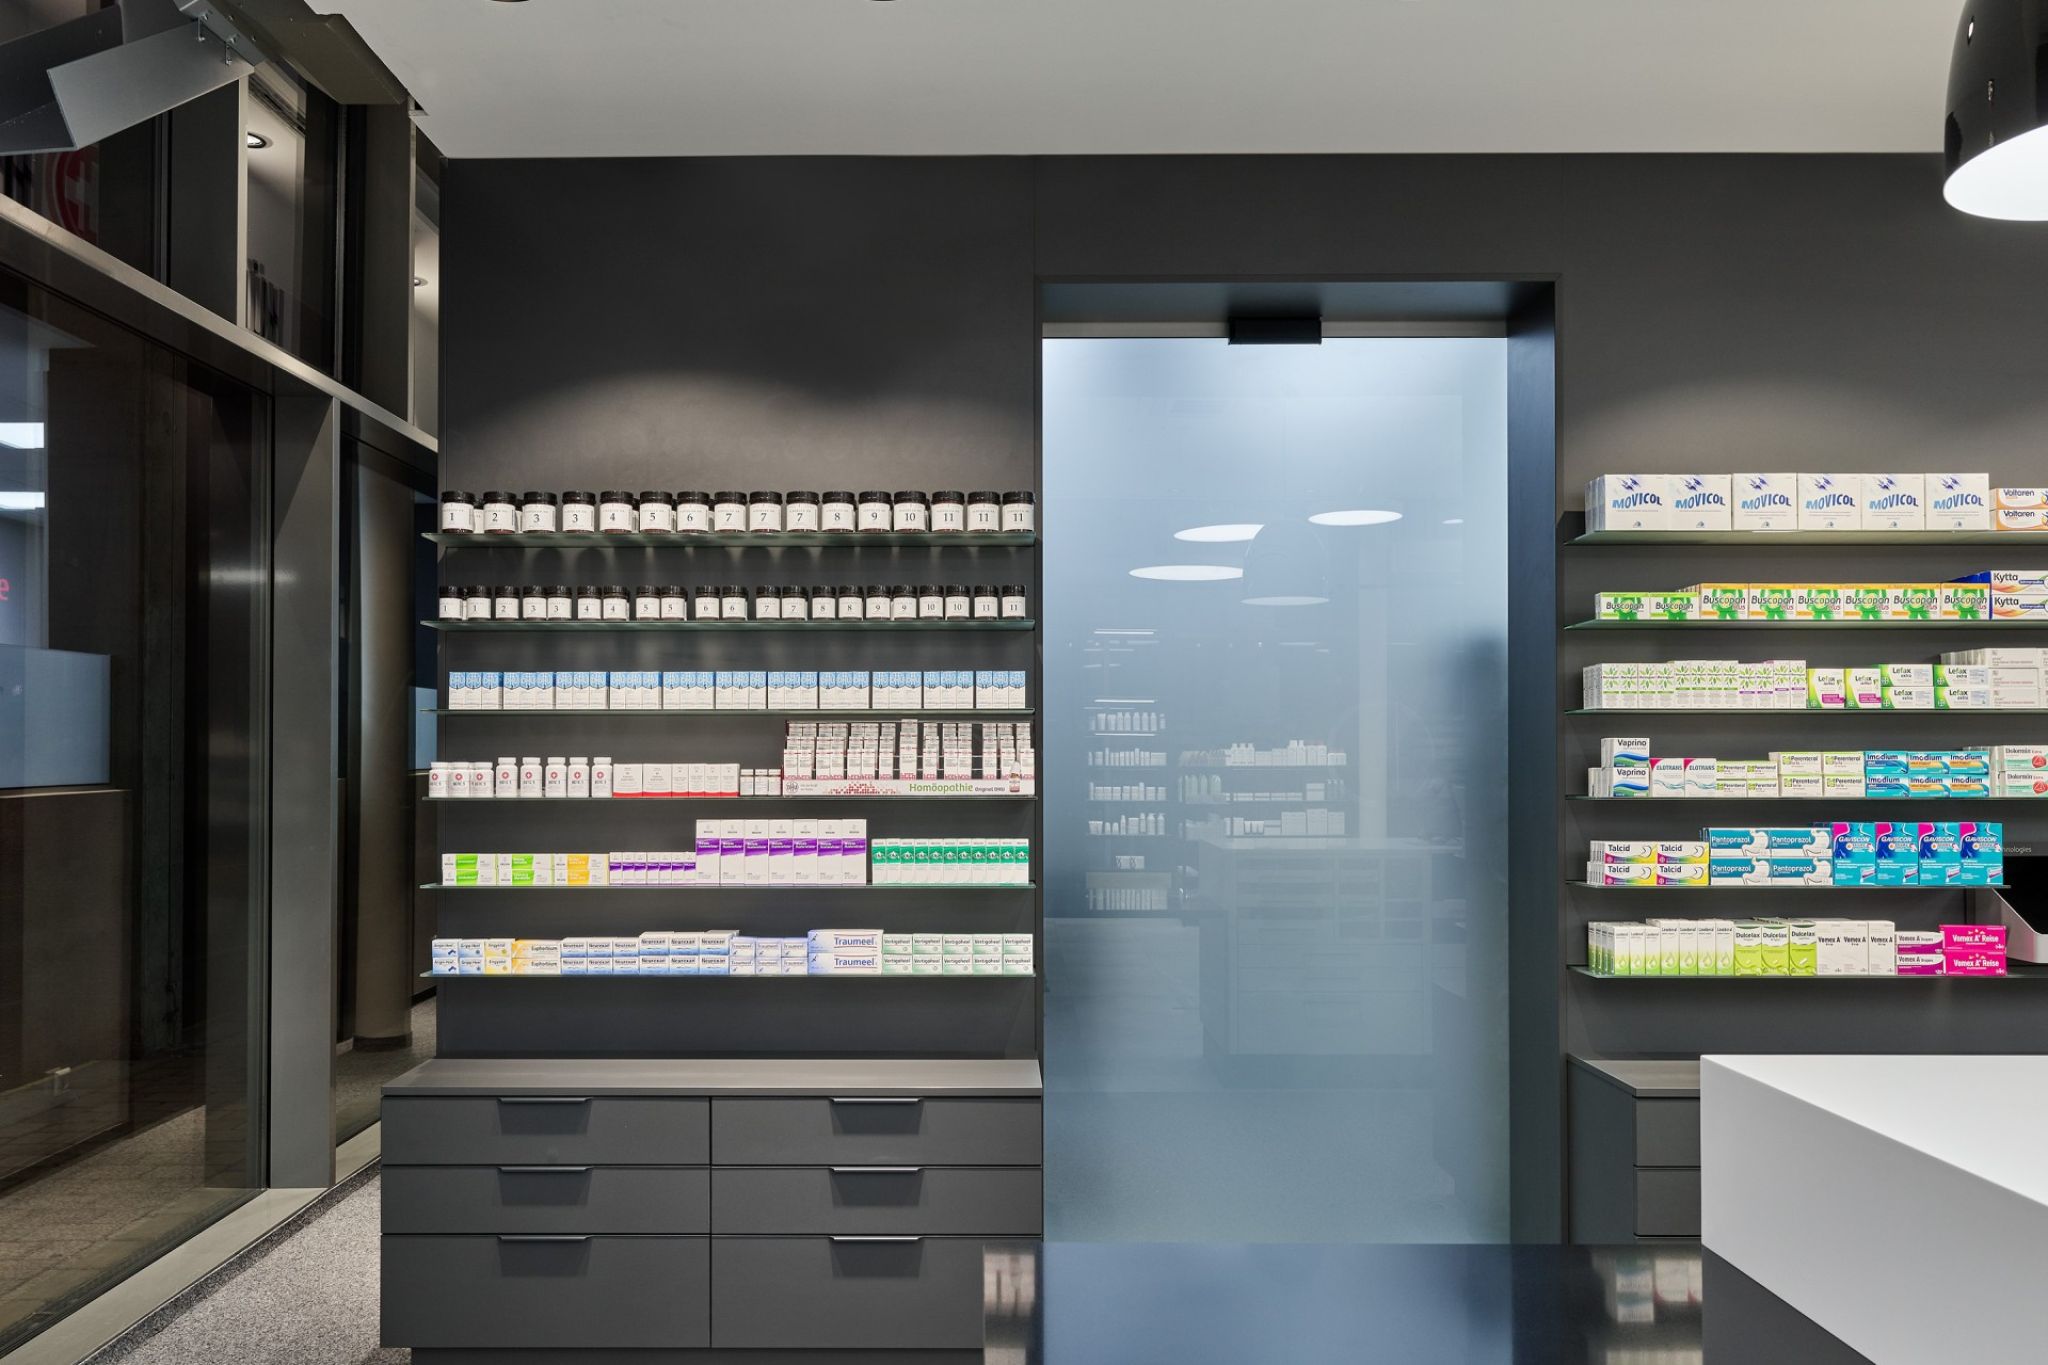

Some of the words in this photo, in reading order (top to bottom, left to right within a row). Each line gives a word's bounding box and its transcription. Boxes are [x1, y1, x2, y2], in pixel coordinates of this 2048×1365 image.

[2004, 489, 2034, 497] Voltaren
[1612, 493, 1662, 509] MOVICOL
[1675, 493, 1725, 509] MOVICOL
[1741, 494, 1791, 510] MOVICOL
[1806, 493, 1856, 510] MOVICOL
[1870, 493, 1919, 510] MOVICOL
[1934, 493, 1984, 510] MOVICOL
[1993, 573, 2018, 582] Kytta
[1703, 595, 1746, 606] Buscopan
[1751, 595, 1794, 606] Buscopan
[1798, 595, 1841, 606] Buscopan
[1846, 595, 1889, 606] Buscopan
[1894, 595, 1938, 606] Buscopan
[1944, 595, 1987, 606] Buscopan
[1994, 597, 2019, 607] Kytta
[1606, 602, 1644, 611] Buscopan
[1656, 602, 1693, 611] Buscopan
[1618, 739, 1646, 747] Vaprino
[1617, 769, 1646, 777] Vaprino
[910, 783, 973, 793] Homöopathie
[1712, 836, 1750, 844] Pantoprazol
[1772, 836, 1811, 844] Pantoprazol
[834, 937, 874, 945] Traumeel
[834, 958, 874, 966] Traumeel
